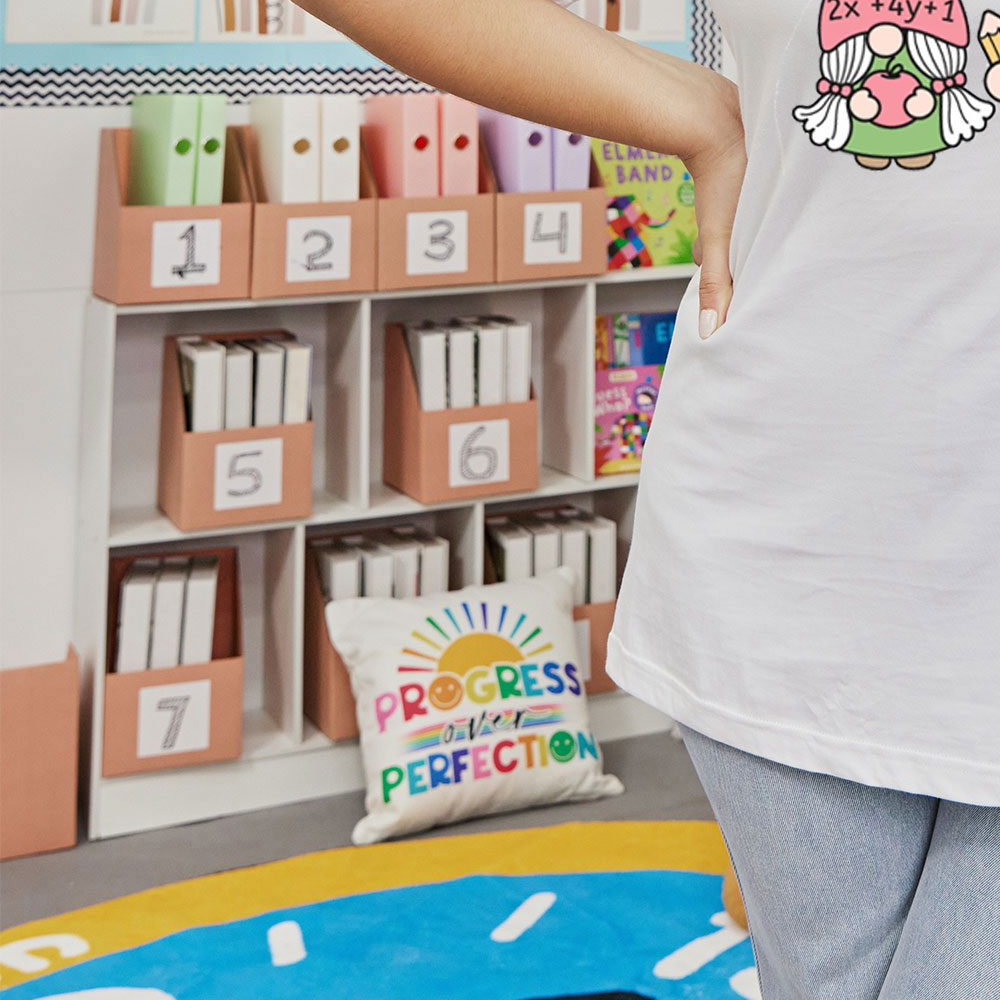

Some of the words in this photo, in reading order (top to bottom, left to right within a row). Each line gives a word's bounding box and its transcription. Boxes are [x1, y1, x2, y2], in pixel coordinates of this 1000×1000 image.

[616, 165, 673, 184] BAND
[172, 224, 207, 279] 1
[302, 229, 334, 271] 2
[423, 219, 456, 262] 3
[532, 211, 568, 254] 4
[228, 450, 263, 496] 5
[459, 425, 499, 481] 6
[375, 661, 582, 734] PROGRESS
[157, 695, 191, 750] 7
[443, 709, 531, 745] over
[382, 730, 600, 804] PERFECTION
